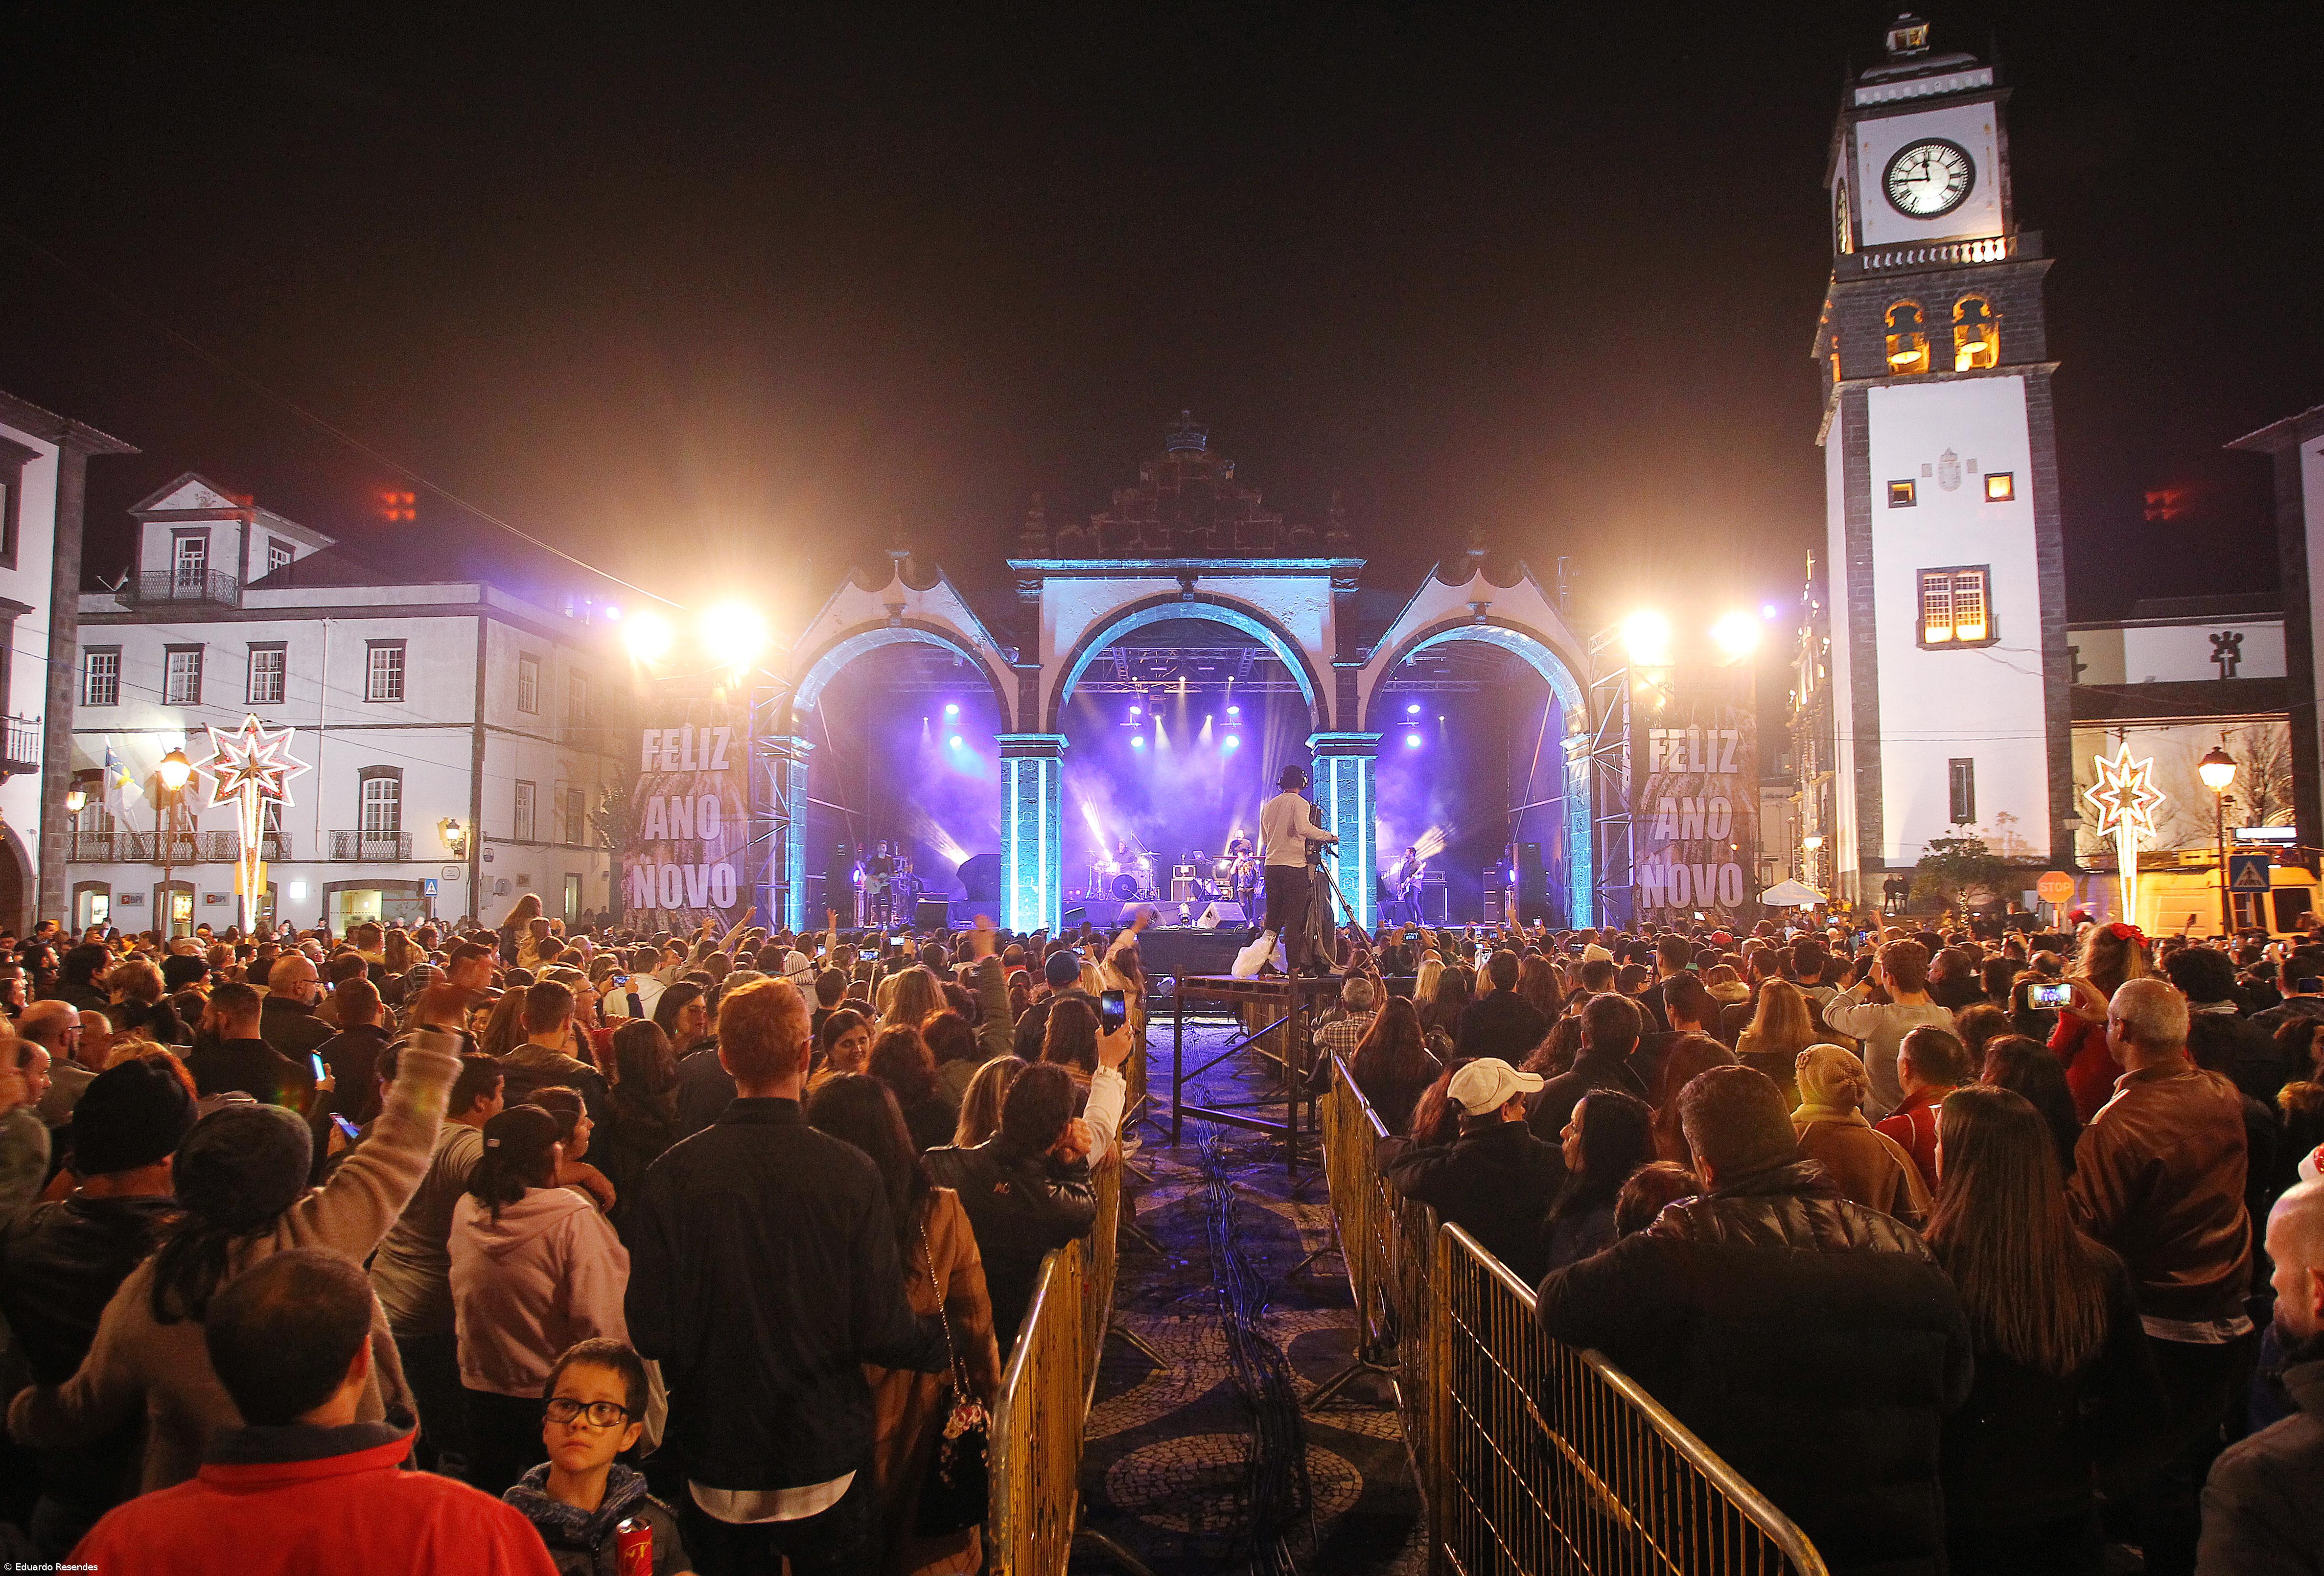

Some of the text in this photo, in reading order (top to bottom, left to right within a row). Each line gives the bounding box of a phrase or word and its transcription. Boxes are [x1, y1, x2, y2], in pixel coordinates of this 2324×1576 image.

[641, 727, 731, 772] FELIZ
[1649, 728, 1738, 773] FELIZ
[644, 794, 720, 840] ANO
[1654, 796, 1732, 840] ANO
[632, 863, 737, 909] NOVO
[1641, 863, 1743, 908] NOVO
[2040, 882, 2071, 892] STOP
